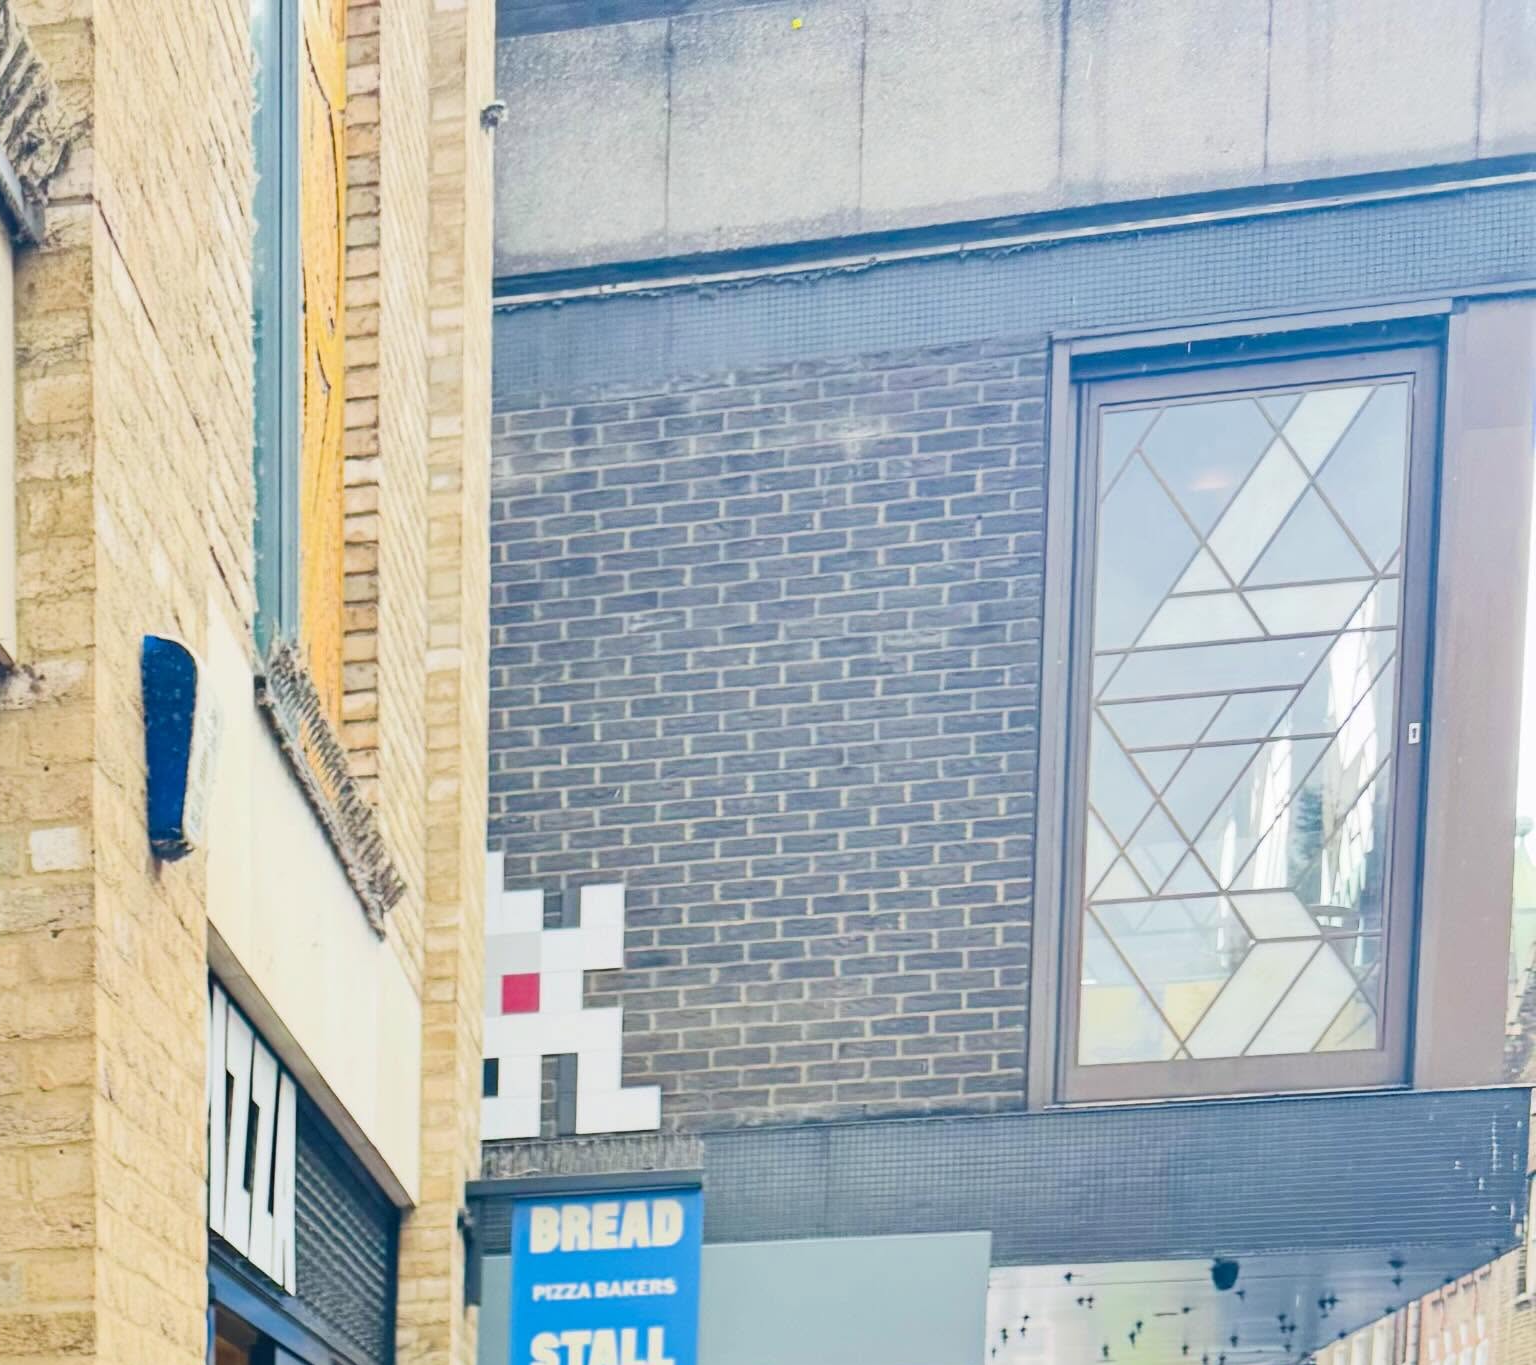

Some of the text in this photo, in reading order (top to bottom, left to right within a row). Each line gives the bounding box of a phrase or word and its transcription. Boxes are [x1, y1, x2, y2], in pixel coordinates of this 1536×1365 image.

[207, 980, 297, 1297] IZZA
[529, 1200, 684, 1254] BREAD
[532, 1278, 677, 1302] PIZZA BAKERS
